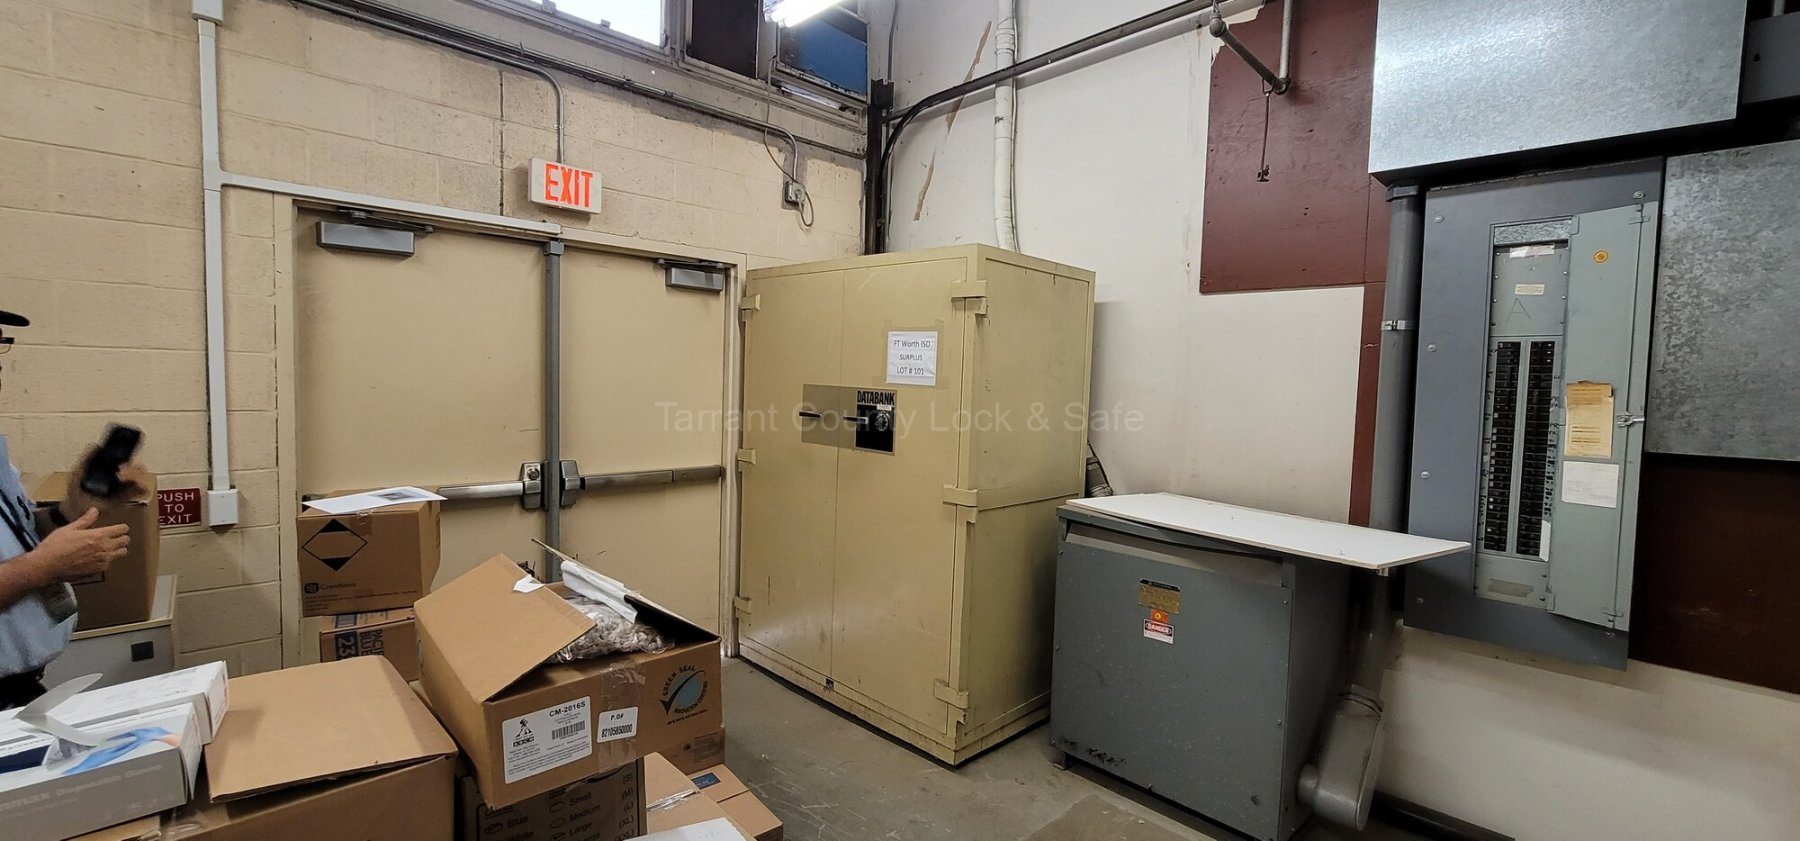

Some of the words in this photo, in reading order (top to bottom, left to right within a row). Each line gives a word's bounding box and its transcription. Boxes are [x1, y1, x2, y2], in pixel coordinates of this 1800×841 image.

[545, 163, 594, 208] EXIT
[893, 340, 901, 348] FT
[902, 340, 919, 348] Worth
[897, 366, 908, 375] LOT
[913, 367, 924, 375] 101
[857, 390, 895, 405] DATABANK
[157, 492, 194, 502] PUSH
[164, 503, 184, 513] TO
[159, 514, 192, 525] EXIT
[662, 672, 677, 696] GREEN
[678, 664, 696, 673] SEAL
[549, 701, 586, 718] CM-2016S
[568, 791, 592, 806] Small
[569, 805, 601, 823] Medium
[507, 816, 529, 828] Blue
[569, 822, 592, 837] Large
